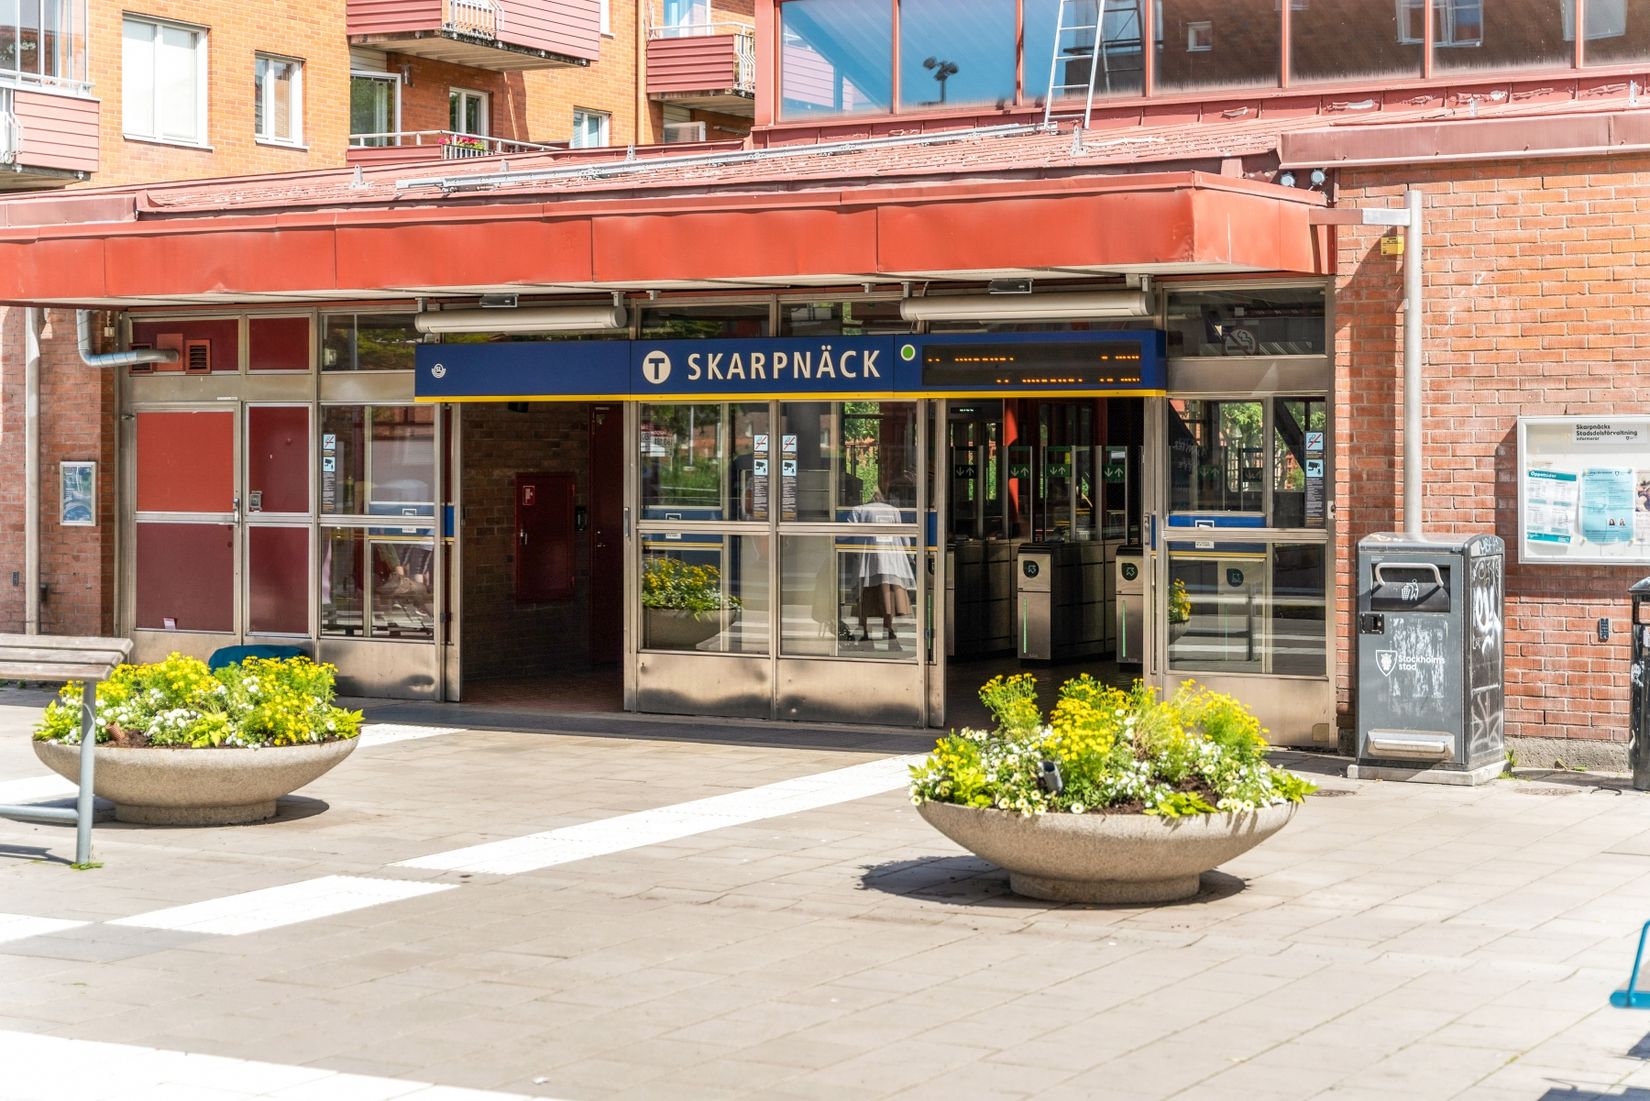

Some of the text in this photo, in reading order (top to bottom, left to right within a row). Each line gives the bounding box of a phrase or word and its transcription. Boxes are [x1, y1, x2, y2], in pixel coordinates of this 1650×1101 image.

[687, 344, 881, 381] SKARPNÄCK
[1575, 423, 1611, 431] Skarpnäcks
[1398, 654, 1446, 664] Stockholms
[1398, 662, 1417, 671] stad
